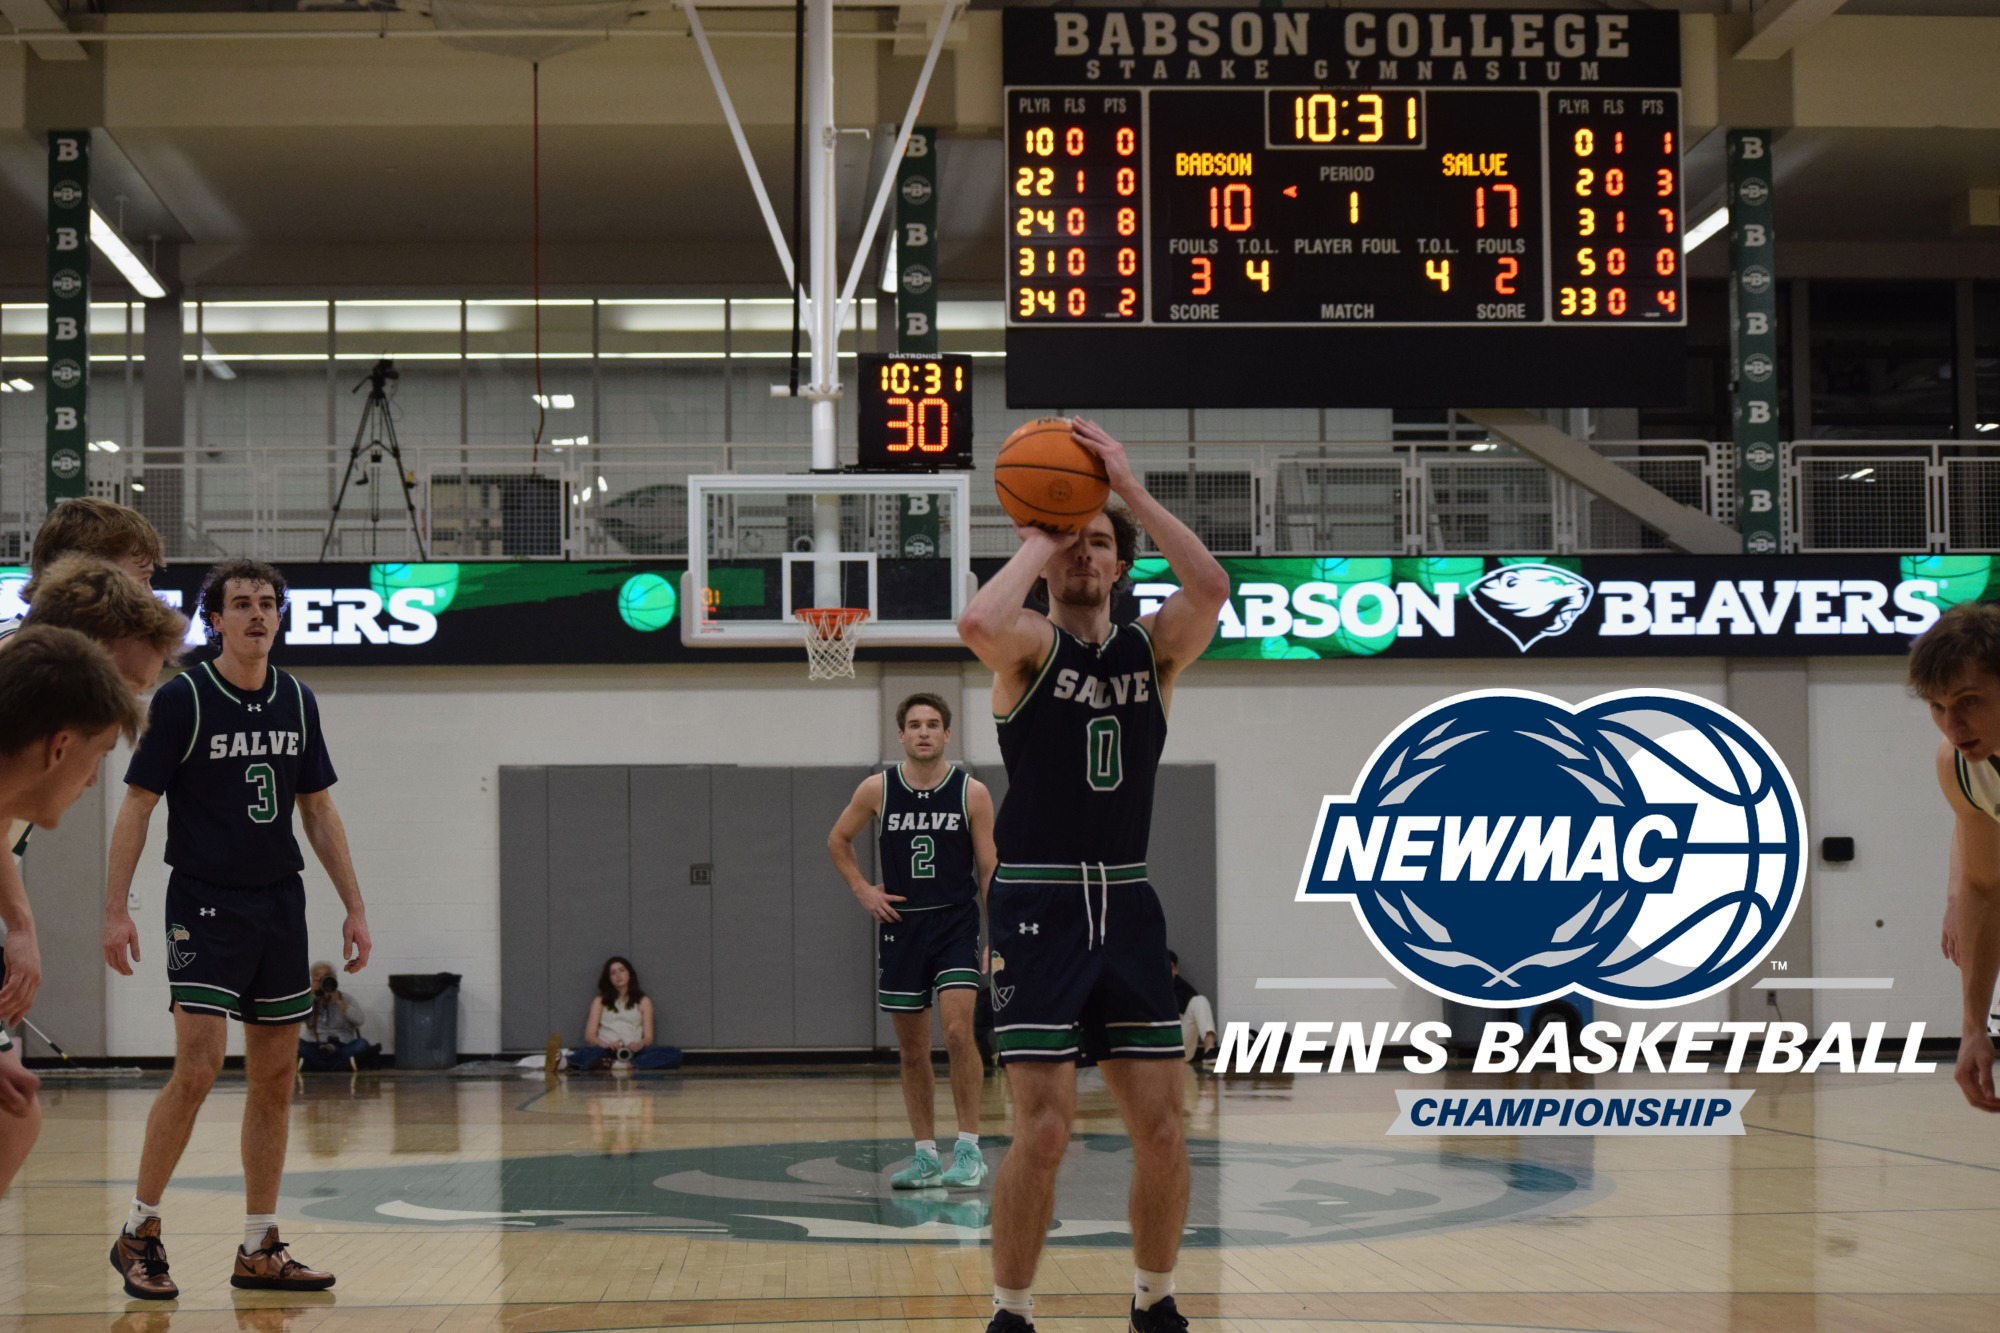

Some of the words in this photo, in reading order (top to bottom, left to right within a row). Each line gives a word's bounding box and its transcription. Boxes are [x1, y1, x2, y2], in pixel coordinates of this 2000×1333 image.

[1054, 12, 1310, 56] BABSON
[1344, 12, 1629, 57] COLLEGE
[1086, 59, 1269, 80] STAAKE
[1314, 59, 1599, 81] GYMNASIUM
[1019, 97, 1050, 113] PLYR
[1064, 97, 1085, 113] FLS
[1104, 97, 1127, 113] PTS
[1558, 99, 1590, 114] PLYR
[1603, 99, 1624, 114] FLS
[1641, 99, 1664, 114] PTS
[1295, 94, 1416, 142] 10:31
[57, 138, 79, 162] B
[907, 134, 928, 158] B
[1026, 127, 1054, 156] 10
[1066, 127, 1084, 156] 0
[1116, 127, 1134, 156] 0
[1575, 128, 1593, 157] 0
[1615, 131, 1623, 154] 1
[1664, 131, 1672, 154] 1
[1742, 137, 1764, 159] B
[1176, 152, 1252, 176] BABSON
[1320, 166, 1374, 181] PERIOD
[1442, 153, 1508, 176] SALVE
[910, 183, 923, 197] B
[1016, 167, 1054, 196] 22
[1077, 170, 1085, 193] 1
[1117, 167, 1134, 196] 0
[1576, 168, 1594, 196] 2
[1605, 168, 1624, 196] 0
[1657, 168, 1673, 196] 3
[1749, 185, 1760, 198] B
[61, 187, 74, 201] B
[1476, 184, 1518, 228] 17
[1210, 184, 1252, 231] 10
[1350, 191, 1359, 224] 1
[1016, 207, 1055, 236] 24
[1067, 207, 1085, 236] 0
[1117, 207, 1135, 236] 8
[1579, 208, 1595, 236] 3
[1616, 211, 1624, 233] 1
[1658, 208, 1674, 233] 7
[56, 228, 78, 251] B
[906, 223, 928, 246] B
[1169, 238, 1219, 254] FOULS
[1237, 238, 1279, 254] T.O.L.
[1294, 238, 1352, 254] PLAYER
[1362, 238, 1400, 254] FOUL
[1417, 238, 1459, 254] T.O.L.
[1477, 238, 1526, 254] FOULS
[1744, 224, 1766, 247] B
[1019, 248, 1055, 276] 31
[1067, 248, 1085, 276] 0
[1118, 248, 1136, 276] 0
[1577, 248, 1596, 276] 5
[1607, 248, 1625, 276] 0
[1656, 248, 1675, 276] 0
[61, 277, 73, 291] B
[911, 272, 924, 286] B
[1191, 257, 1211, 295] 3
[1246, 259, 1270, 292] 4
[1426, 259, 1450, 292] 4
[1495, 257, 1518, 294] 2
[1751, 272, 1763, 286] B
[1019, 288, 1056, 316] 34
[1068, 288, 1086, 316] 0
[1118, 288, 1136, 316] 2
[1170, 304, 1220, 320] SCORE
[1321, 304, 1375, 319] MATCH
[1477, 304, 1526, 319] SCORE
[1560, 288, 1597, 315] 33
[1608, 288, 1626, 315] 0
[1657, 290, 1676, 313] 4
[55, 317, 78, 341] B
[906, 312, 929, 336] B
[1746, 312, 1769, 335] B
[60, 366, 73, 381] B
[881, 362, 963, 395] 10:31
[1753, 361, 1765, 374] B
[54, 407, 77, 430] B
[1748, 400, 1771, 424] B
[886, 397, 949, 452] 30
[60, 456, 72, 470] B
[1754, 450, 1766, 463] B
[908, 493, 931, 516] B
[1750, 489, 1773, 512] B
[913, 542, 926, 556] B
[1756, 538, 1768, 552] B
[1598, 580, 1941, 636] BEAVERS
[1053, 668, 1150, 709] SALVE
[209, 730, 299, 760] SALVE
[1086, 715, 1123, 791] 0
[245, 762, 278, 823] 3
[887, 812, 961, 831] SALVE
[911, 835, 936, 879] 2
